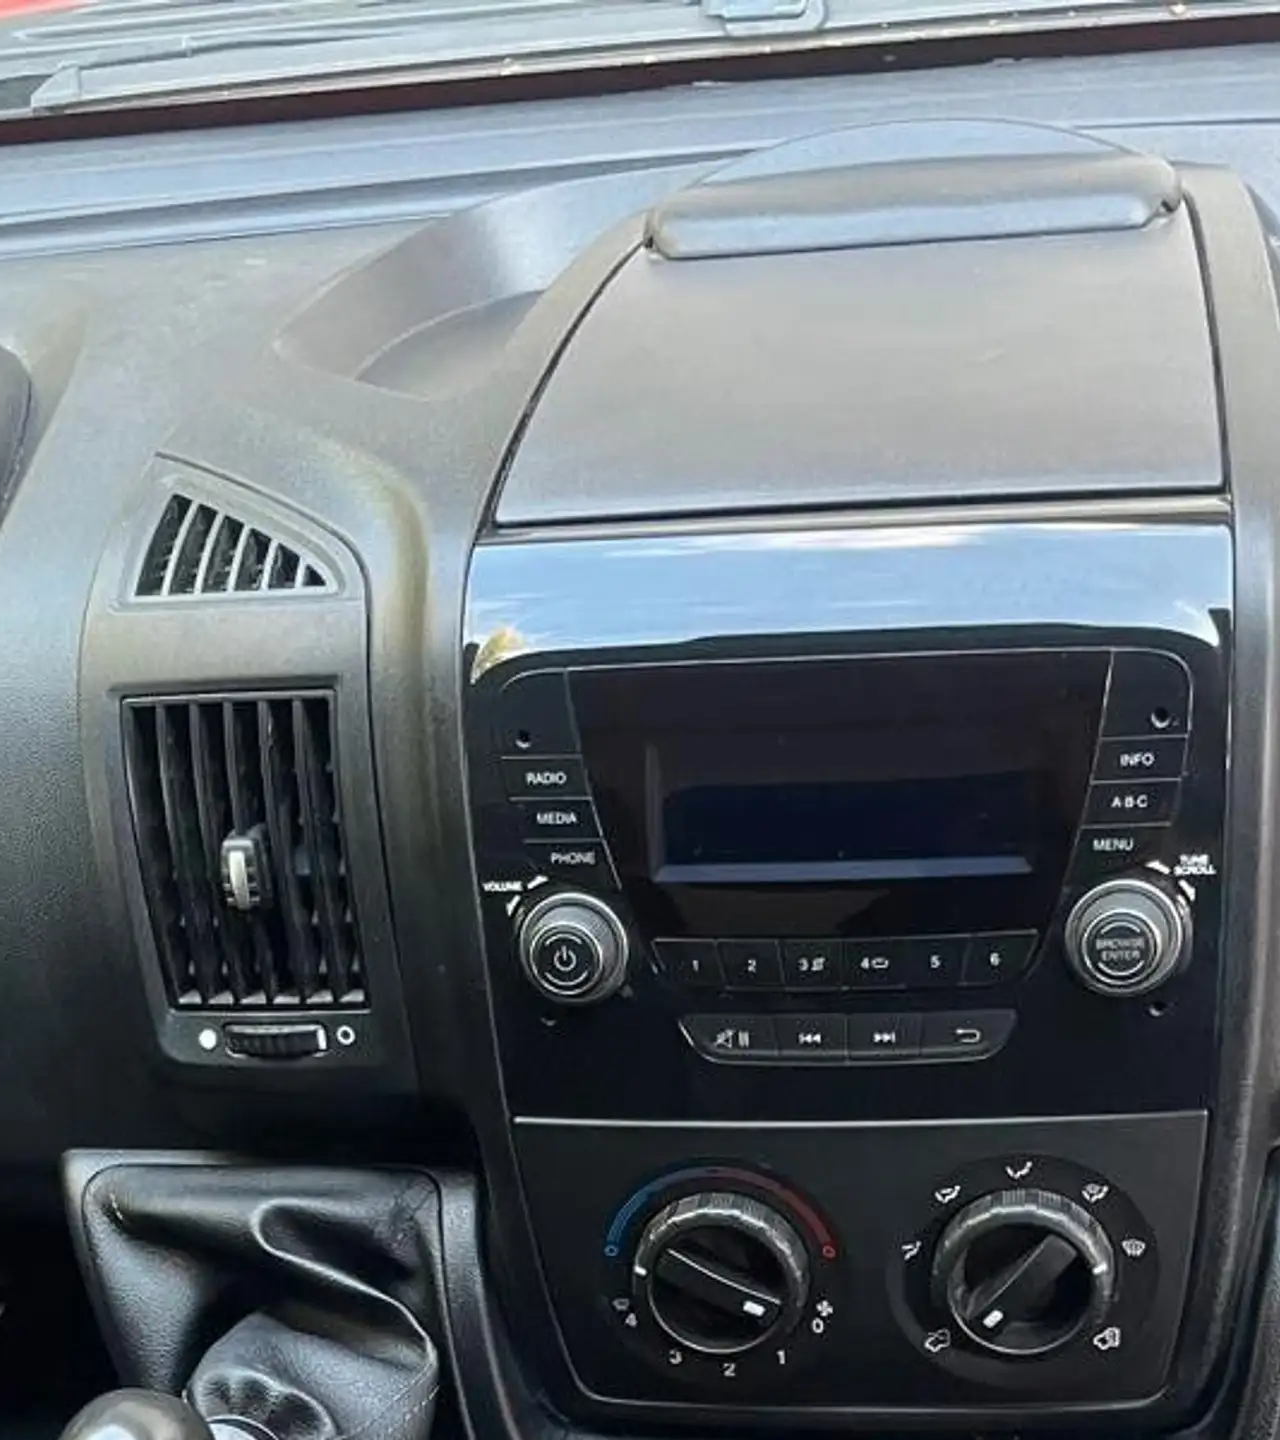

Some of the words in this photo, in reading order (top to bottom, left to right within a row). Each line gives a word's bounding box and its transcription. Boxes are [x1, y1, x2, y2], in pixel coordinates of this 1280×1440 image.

[1120, 752, 1155, 767] INFO
[525, 771, 567, 785] RADIO
[536, 811, 577, 824] MEDIA
[1093, 838, 1134, 851] MENU
[550, 851, 596, 865] PHONE
[1173, 865, 1217, 876] SCROLL
[482, 881, 522, 891] VOLUME
[692, 959, 700, 972] 1
[747, 959, 757, 972] 2
[797, 958, 809, 972] 3
[860, 957, 870, 970] 4
[930, 955, 941, 968] 5
[989, 952, 1001, 967] 6
[1101, 951, 1141, 961] ENTER
[625, 1312, 638, 1328] 4
[812, 1317, 825, 1334] 0
[776, 1349, 787, 1365] 1
[722, 1362, 736, 1377] 2
